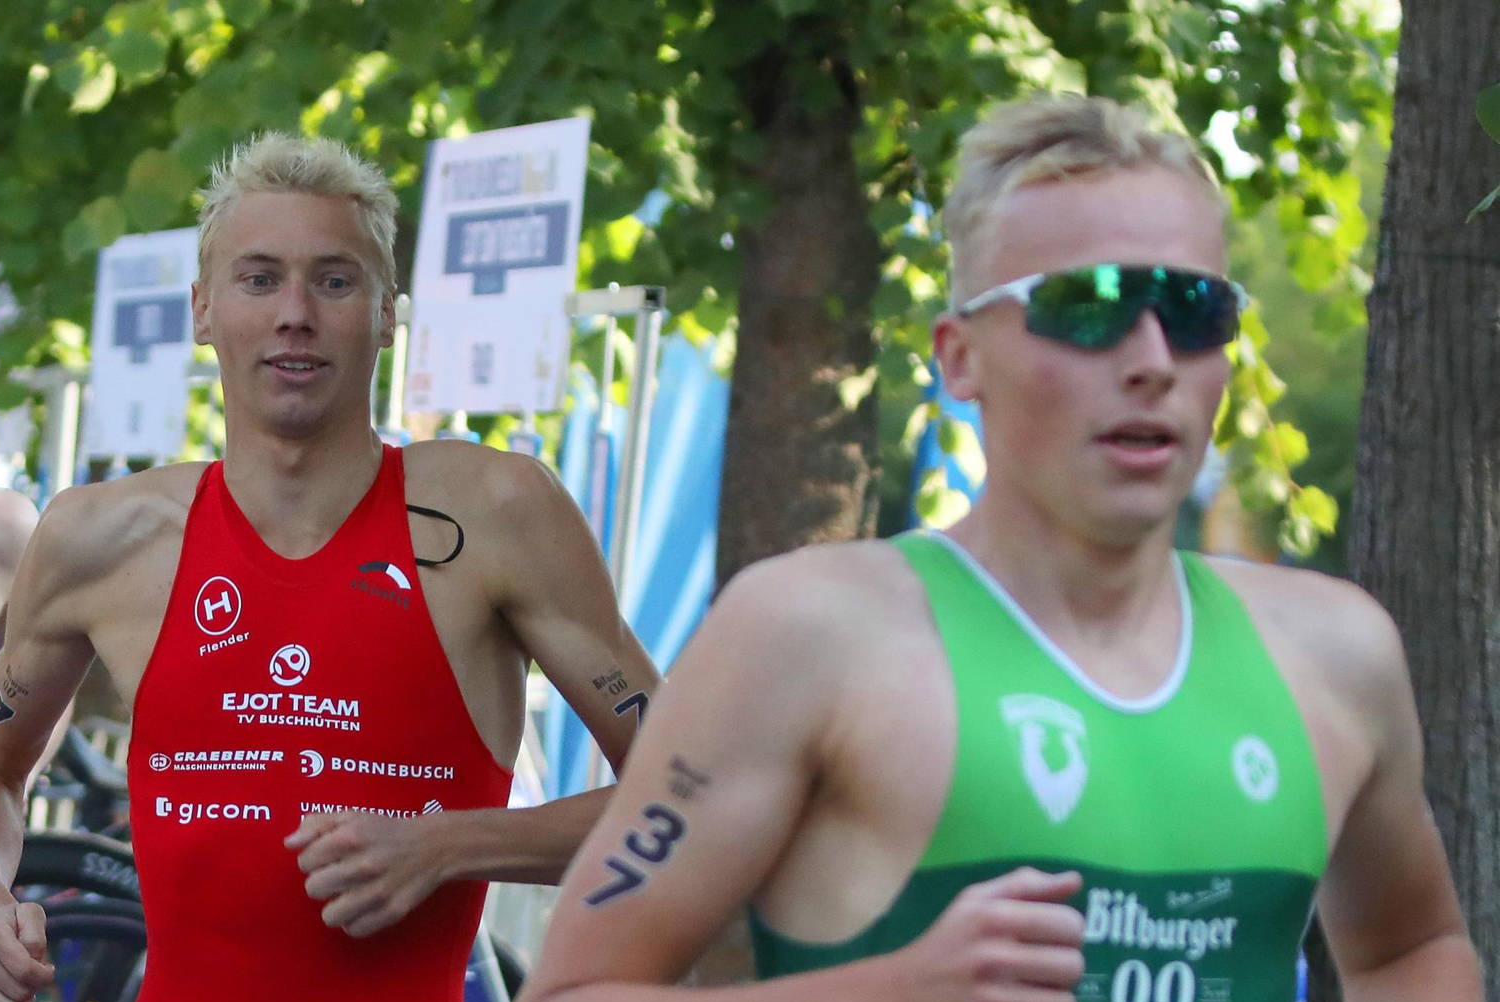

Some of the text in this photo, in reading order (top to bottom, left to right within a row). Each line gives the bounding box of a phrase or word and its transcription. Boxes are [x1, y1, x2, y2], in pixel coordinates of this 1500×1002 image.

[198, 630, 251, 657] Flender
[221, 692, 360, 718] EJOT TEAM
[237, 714, 361, 732] TV BUSCHHÜTTEN
[173, 750, 284, 763] GRAEBENER
[173, 763, 267, 771] MASCHINENTECHNIK
[330, 757, 455, 780] BORNEBUSCH
[179, 803, 271, 825] gicom
[1082, 888, 1237, 959] Bitburger
